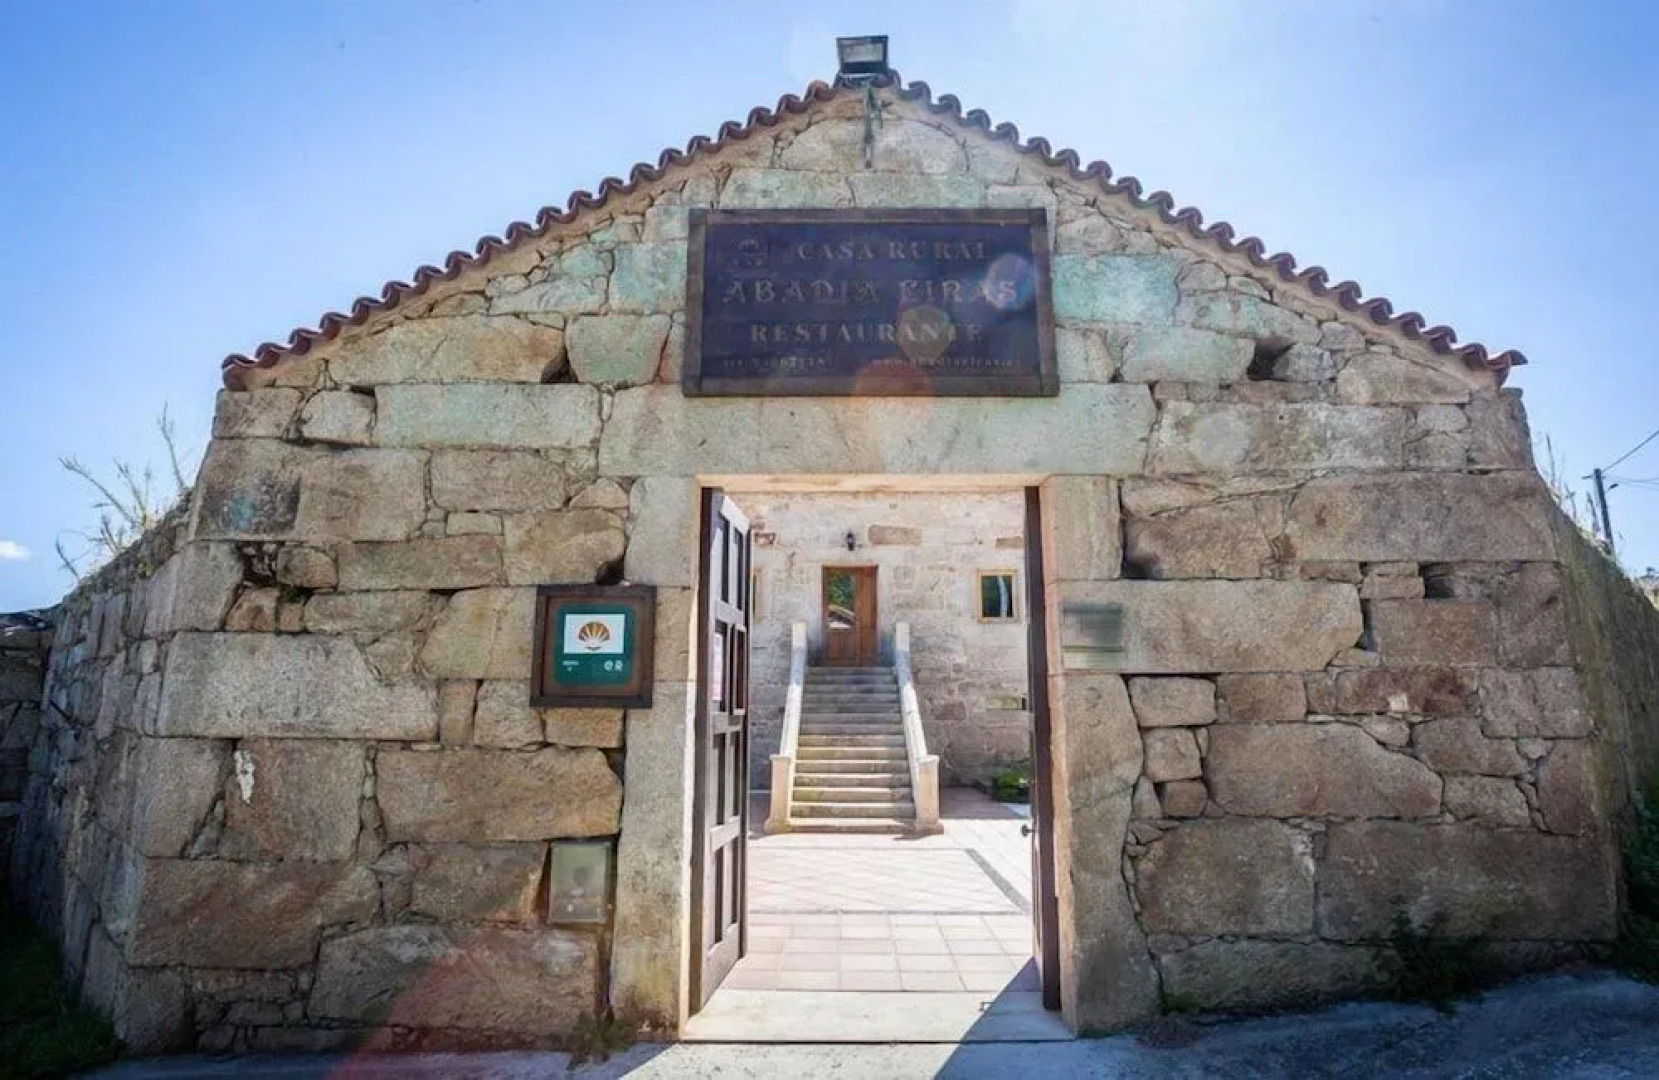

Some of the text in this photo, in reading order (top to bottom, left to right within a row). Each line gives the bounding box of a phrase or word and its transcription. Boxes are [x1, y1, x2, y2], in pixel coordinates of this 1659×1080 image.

[798, 240, 988, 260] CASA RURAL
[899, 278, 1018, 304] EIRAS
[750, 322, 984, 345] RESTAURANTE
